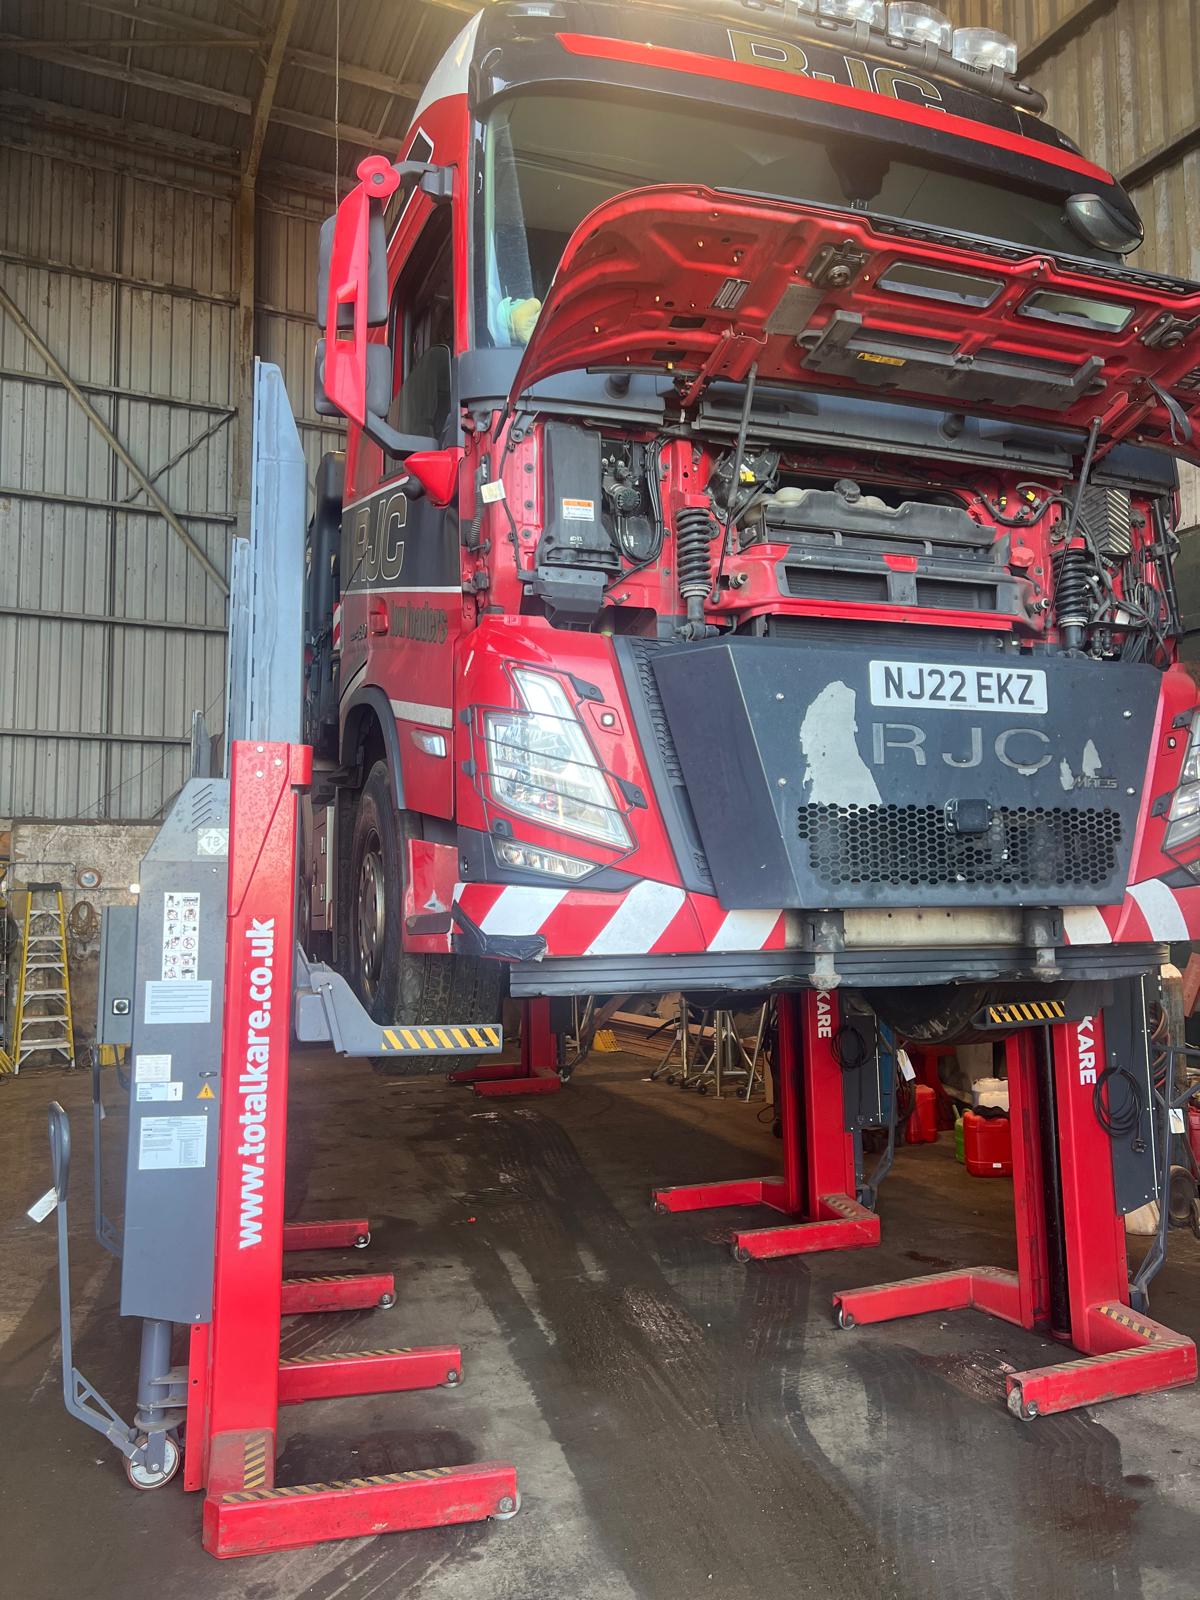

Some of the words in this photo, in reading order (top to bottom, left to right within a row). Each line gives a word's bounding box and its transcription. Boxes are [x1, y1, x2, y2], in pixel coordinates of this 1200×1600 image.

[353, 492, 408, 582] RJC
[884, 666, 967, 703] NJ22
[976, 671, 1035, 706] EKZ
[872, 722, 1052, 769] RJC
[238, 917, 275, 1250] www.totalkare.co.uk
[1077, 1015, 1097, 1086] KARE
